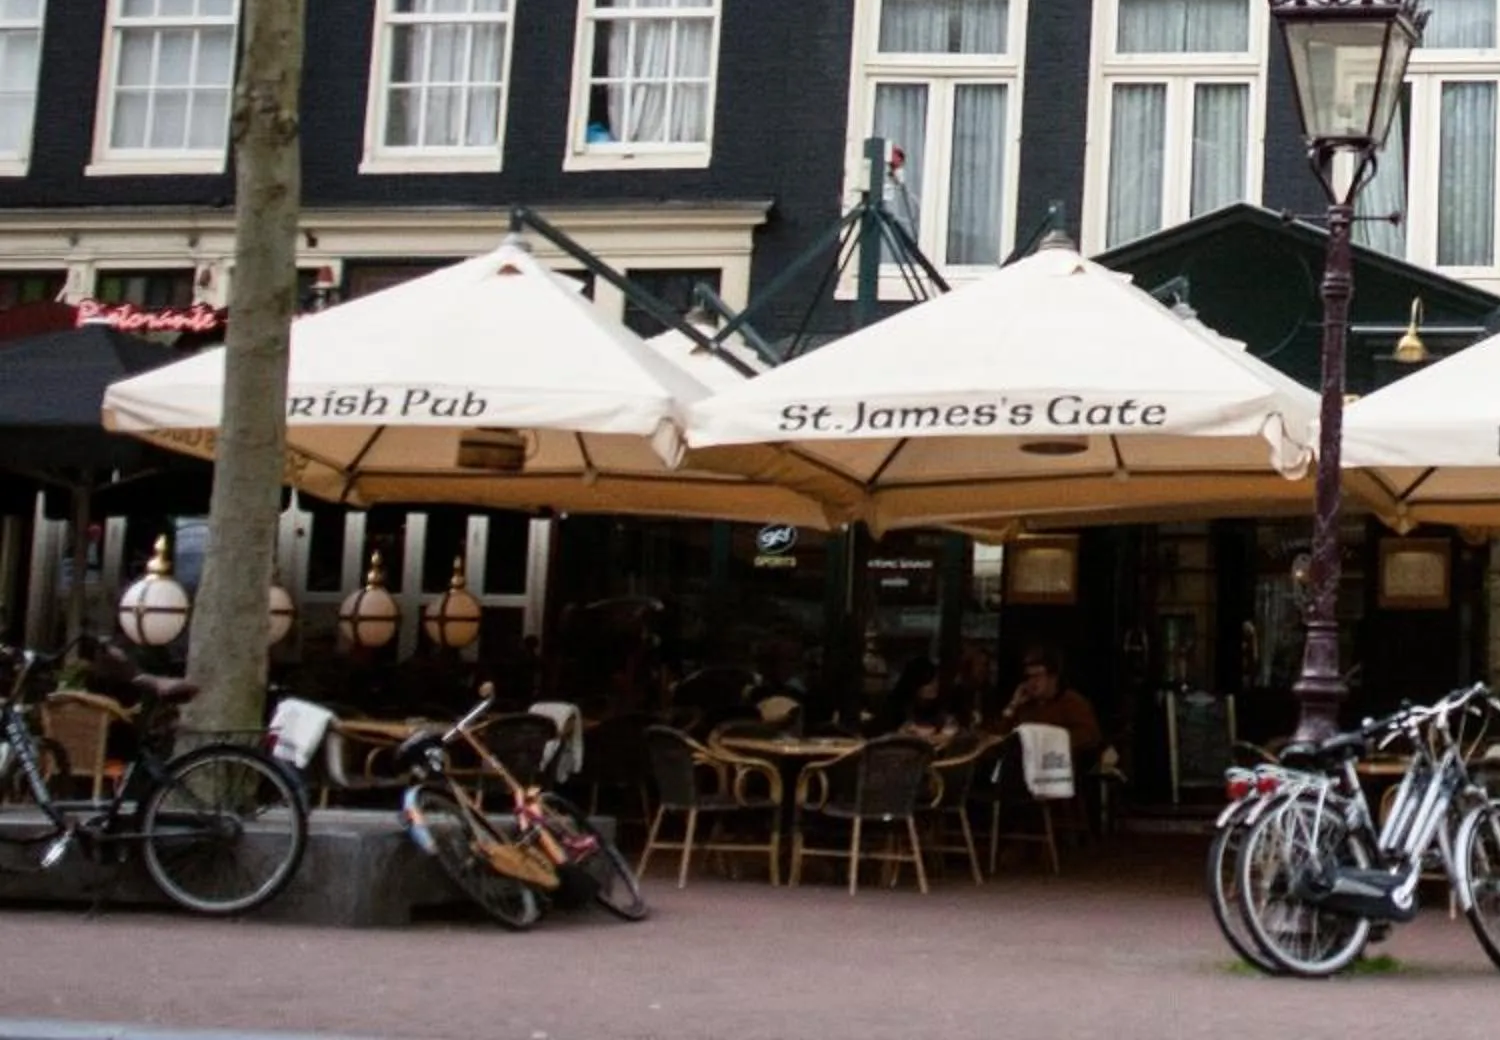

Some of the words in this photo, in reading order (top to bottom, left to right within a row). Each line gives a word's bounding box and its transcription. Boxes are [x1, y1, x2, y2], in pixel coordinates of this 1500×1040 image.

[287, 388, 389, 418] rish
[399, 388, 488, 418] Pub
[1045, 394, 1168, 427] Gate
